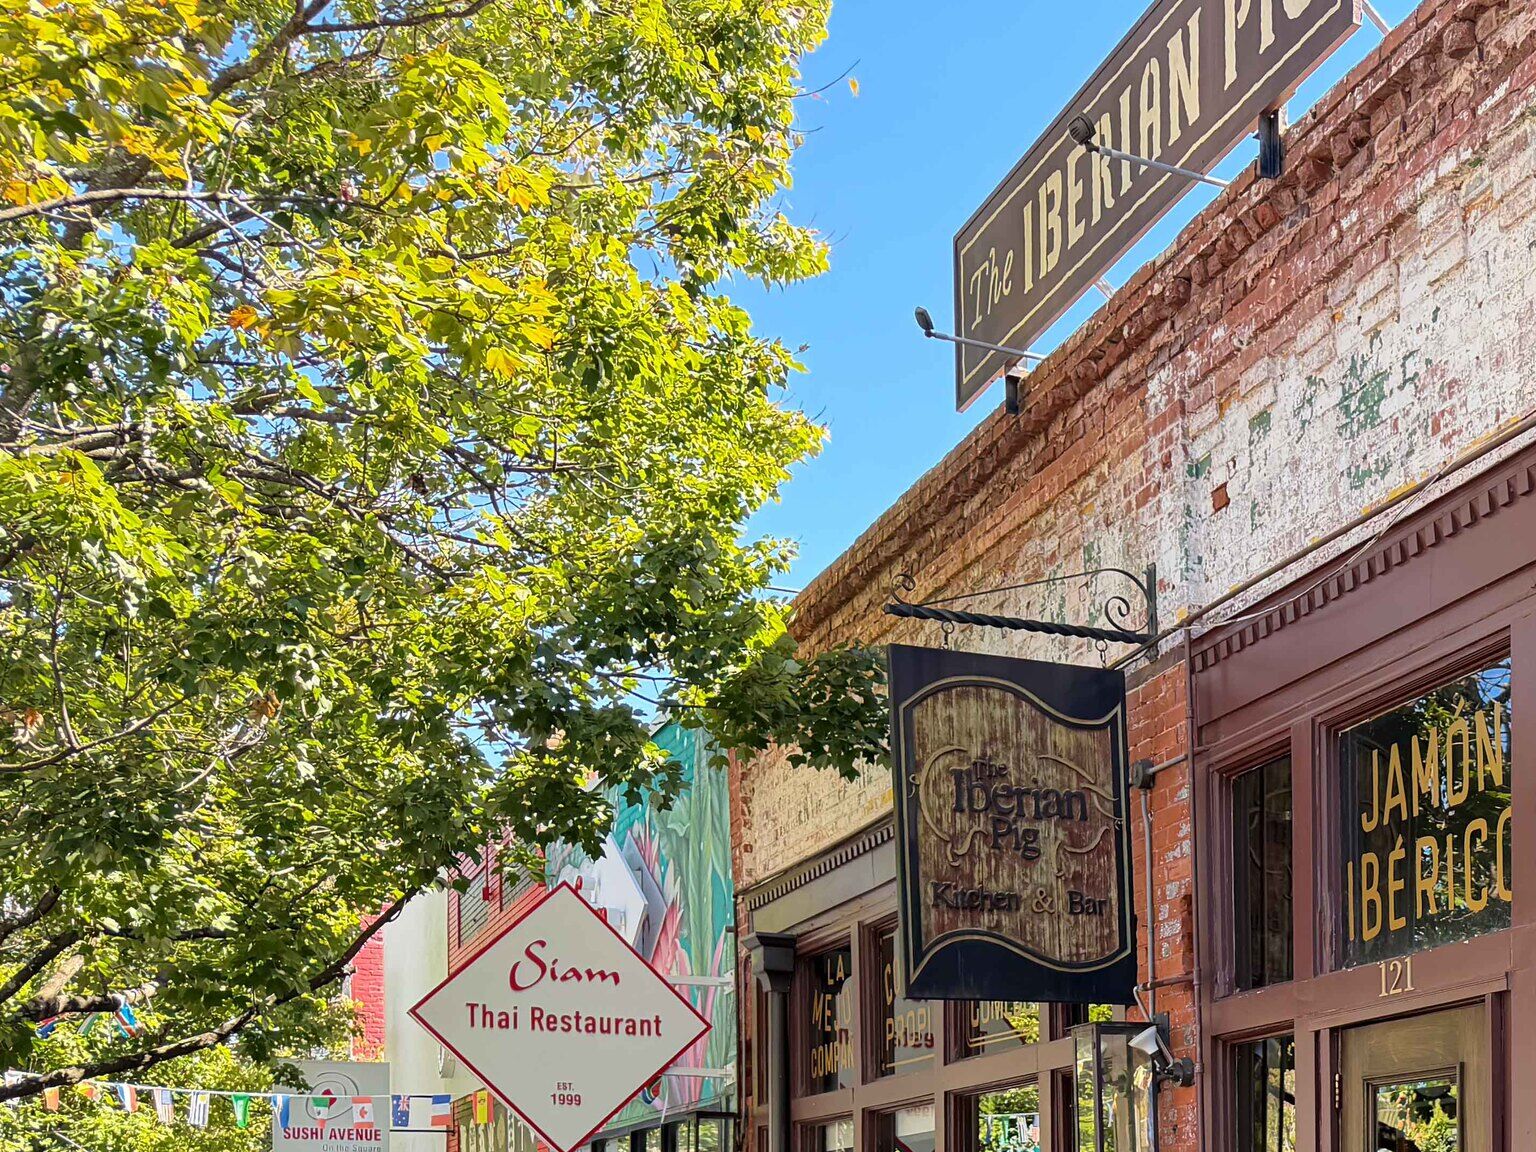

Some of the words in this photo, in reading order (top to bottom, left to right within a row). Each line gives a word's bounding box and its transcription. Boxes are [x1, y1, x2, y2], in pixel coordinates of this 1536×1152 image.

[968, 246, 1014, 331] The
[1023, 6, 1201, 294] IBERIAN
[973, 758, 1008, 777] The
[1361, 698, 1503, 834] JAMÓN
[949, 766, 1088, 822] Iberian
[990, 814, 1041, 861] Pig
[930, 880, 1021, 913] Kitchen
[1031, 887, 1056, 914] &
[1067, 890, 1110, 916] Bar
[509, 939, 620, 992] Siam
[827, 954, 845, 985] LA
[1377, 958, 1415, 998] 121
[465, 1002, 519, 1030] Thai
[530, 1006, 662, 1037] Restaurant
[551, 1093, 581, 1107] 1999
[557, 1082, 574, 1091] EST.
[283, 1127, 324, 1141] SUSHI
[329, 1128, 382, 1142] AVENUE
[322, 1144, 334, 1152] On
[336, 1144, 349, 1152] the
